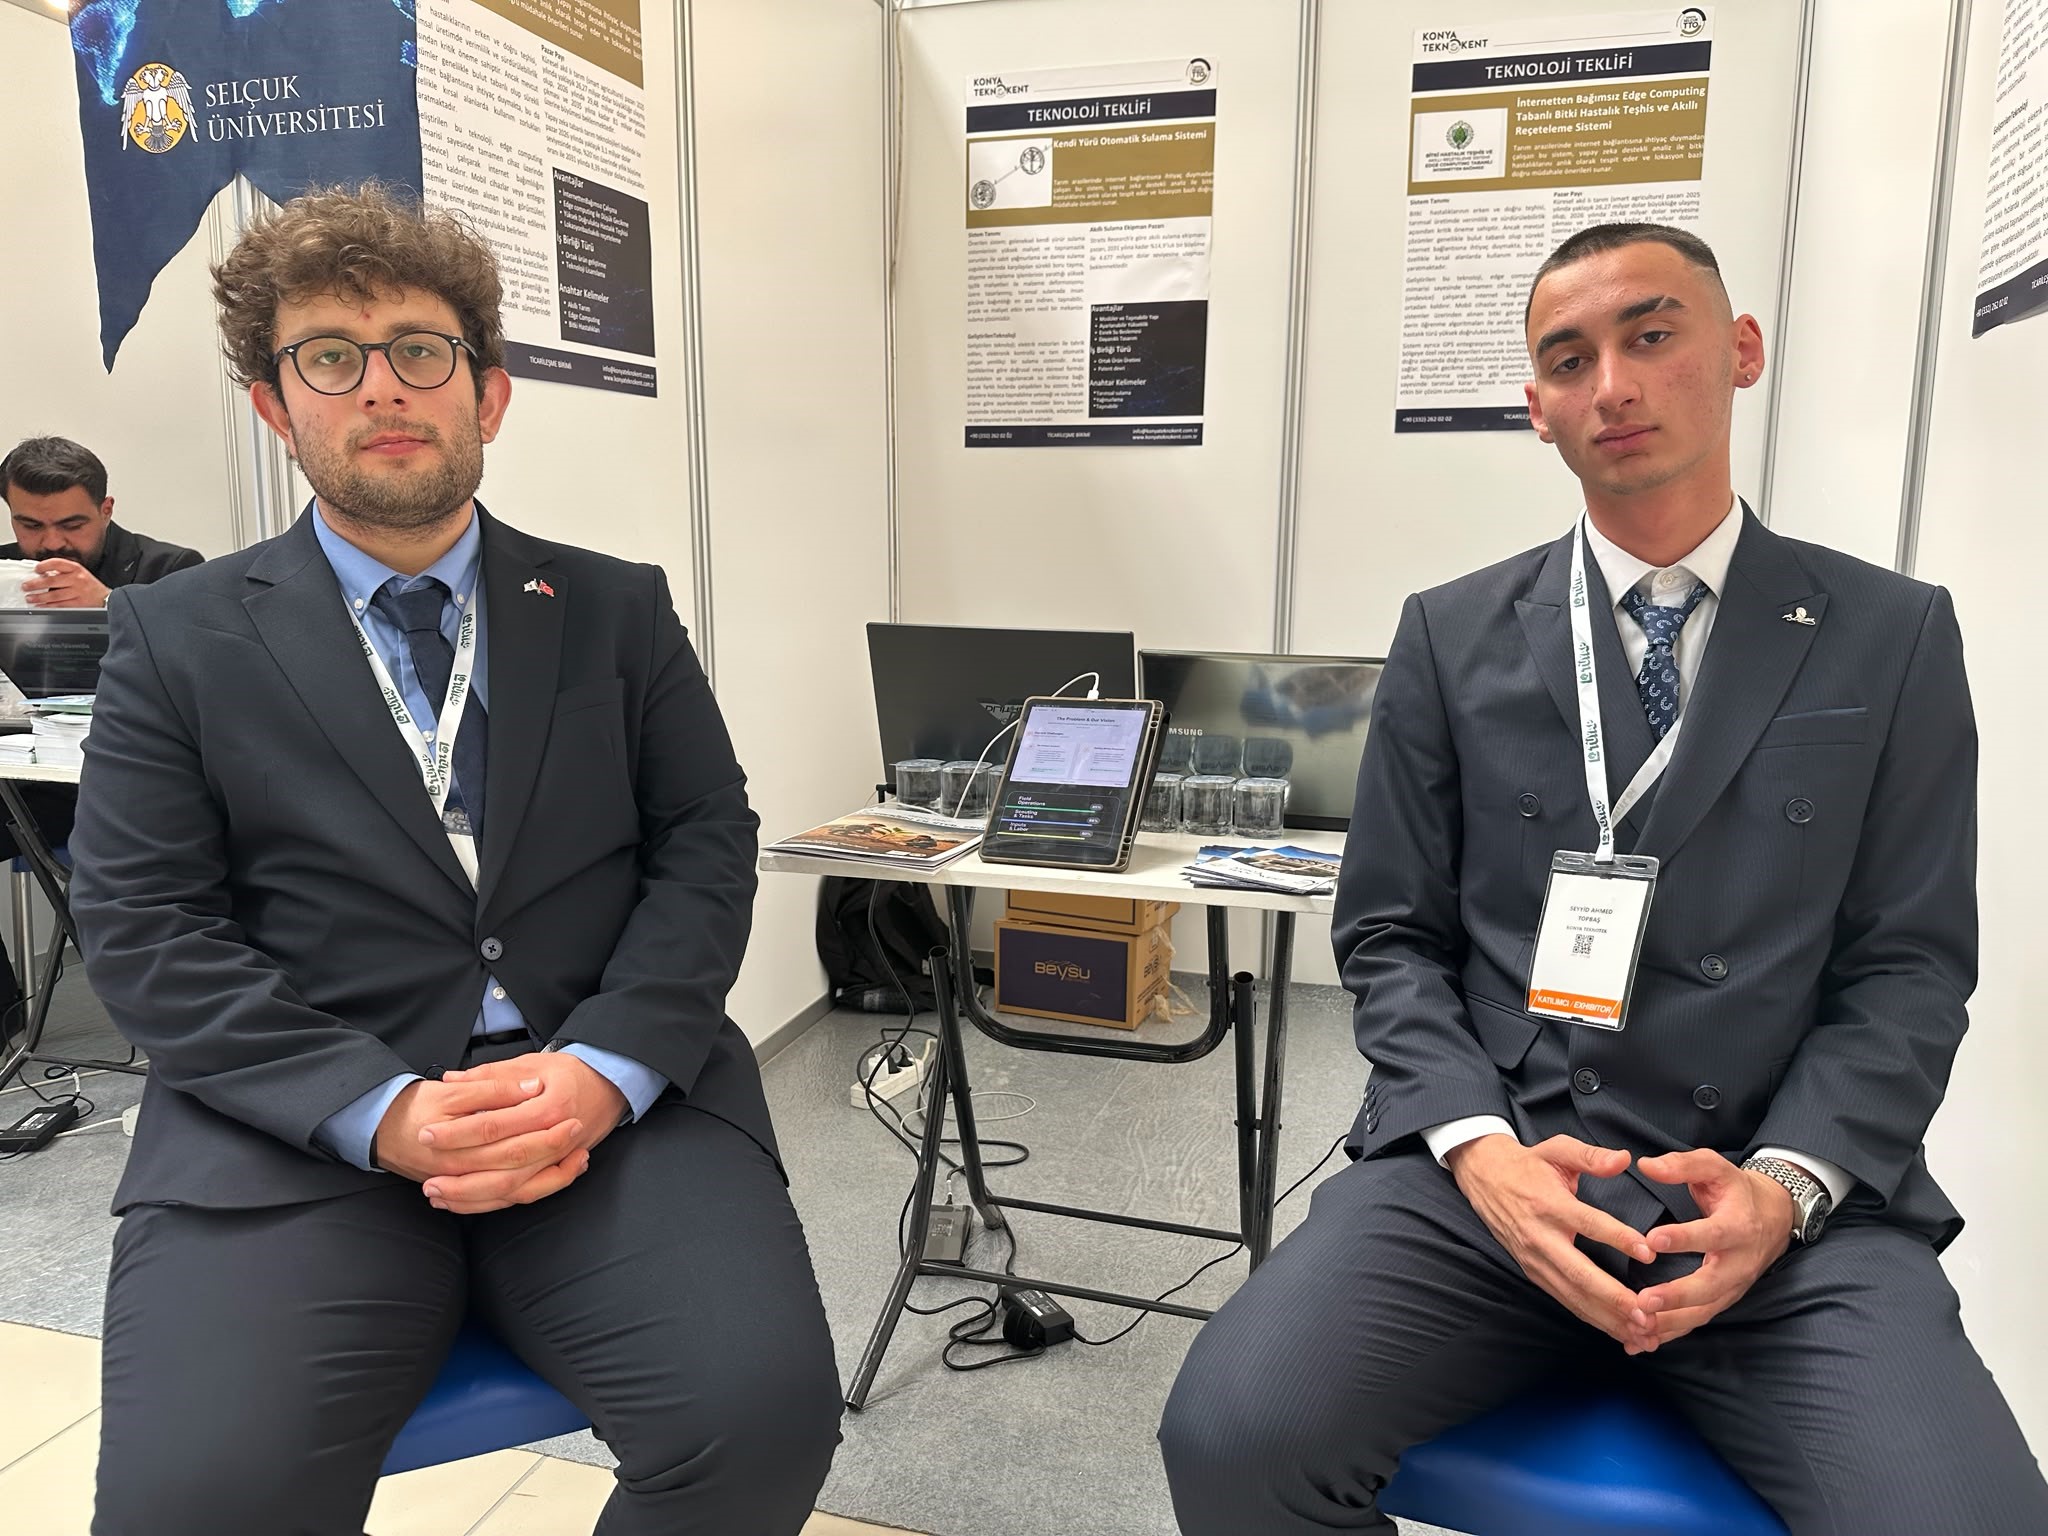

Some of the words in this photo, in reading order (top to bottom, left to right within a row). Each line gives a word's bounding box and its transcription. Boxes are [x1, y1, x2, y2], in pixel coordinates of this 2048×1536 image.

[436, 24, 463, 43] üretimde
[475, 29, 490, 41] erken
[1422, 31, 1456, 40] KONYA
[541, 44, 554, 56] Pazar
[441, 41, 455, 54] kritik
[458, 49, 478, 64] öneme
[505, 71, 519, 82] Ancak
[1485, 58, 1571, 79] TEKNOLOJİ
[1576, 52, 1632, 72] TEKLİFİ
[442, 58, 468, 75] genellikle
[472, 69, 487, 82] bulut
[511, 87, 521, 98] olup
[974, 77, 1002, 86] KONYA
[206, 76, 300, 109] SELÇUK
[443, 86, 458, 98] kırsal
[464, 95, 488, 111] alanlarda
[1517, 95, 1573, 107] İnternetten
[1576, 93, 1619, 104] Bağımsız
[1623, 91, 1646, 101] Edge
[1650, 87, 1705, 99] Computing
[525, 106, 531, 116] bu
[534, 111, 540, 119] da
[1028, 102, 1099, 122] TEKNOLOJİ
[1103, 99, 1151, 117] TEKLİFİ
[1516, 110, 1552, 121] Tabanlı
[1555, 108, 1577, 119] Bitki
[1580, 106, 1620, 117] Hastalık
[1623, 103, 1654, 116] Teşhis
[1672, 101, 1698, 111] Akıllı
[208, 99, 386, 142] ÜNİVERSİTESİ
[1515, 123, 1572, 136] Reçeteleme
[1575, 121, 1612, 132] Sistemi
[455, 123, 462, 133] bu
[500, 143, 512, 152] edge
[1054, 137, 1076, 148] Kendi
[1079, 135, 1098, 146] Yürü
[1100, 133, 1140, 145] Otomatik
[1142, 131, 1172, 143] Sulama
[1175, 130, 1207, 141] Sistemi
[1603, 138, 1642, 146] bağlantısına
[447, 136, 474, 152] sayesinde
[478, 147, 503, 162] tamamen
[507, 158, 519, 168] cihaz
[488, 164, 509, 178] internet
[554, 170, 584, 188] Avantajlar
[452, 180, 479, 195] üzerinden
[503, 197, 514, 207] bitki
[471, 172, 486, 184] Mobil
[490, 179, 509, 192] cihazlar
[512, 188, 524, 197] veya
[440, 190, 465, 205] öğrenme
[511, 213, 525, 224] analiz
[581, 239, 594, 252] Türü
[565, 251, 577, 260] Ortak
[560, 283, 582, 296] Anahtar
[584, 289, 609, 303] Kelimeler
[1168, 727, 1203, 736] MSUNG
[1034, 961, 1090, 980] Beysu
[1538, 996, 1569, 1006] KATILIMCI
[1574, 1002, 1612, 1013] EXHIBITOR
